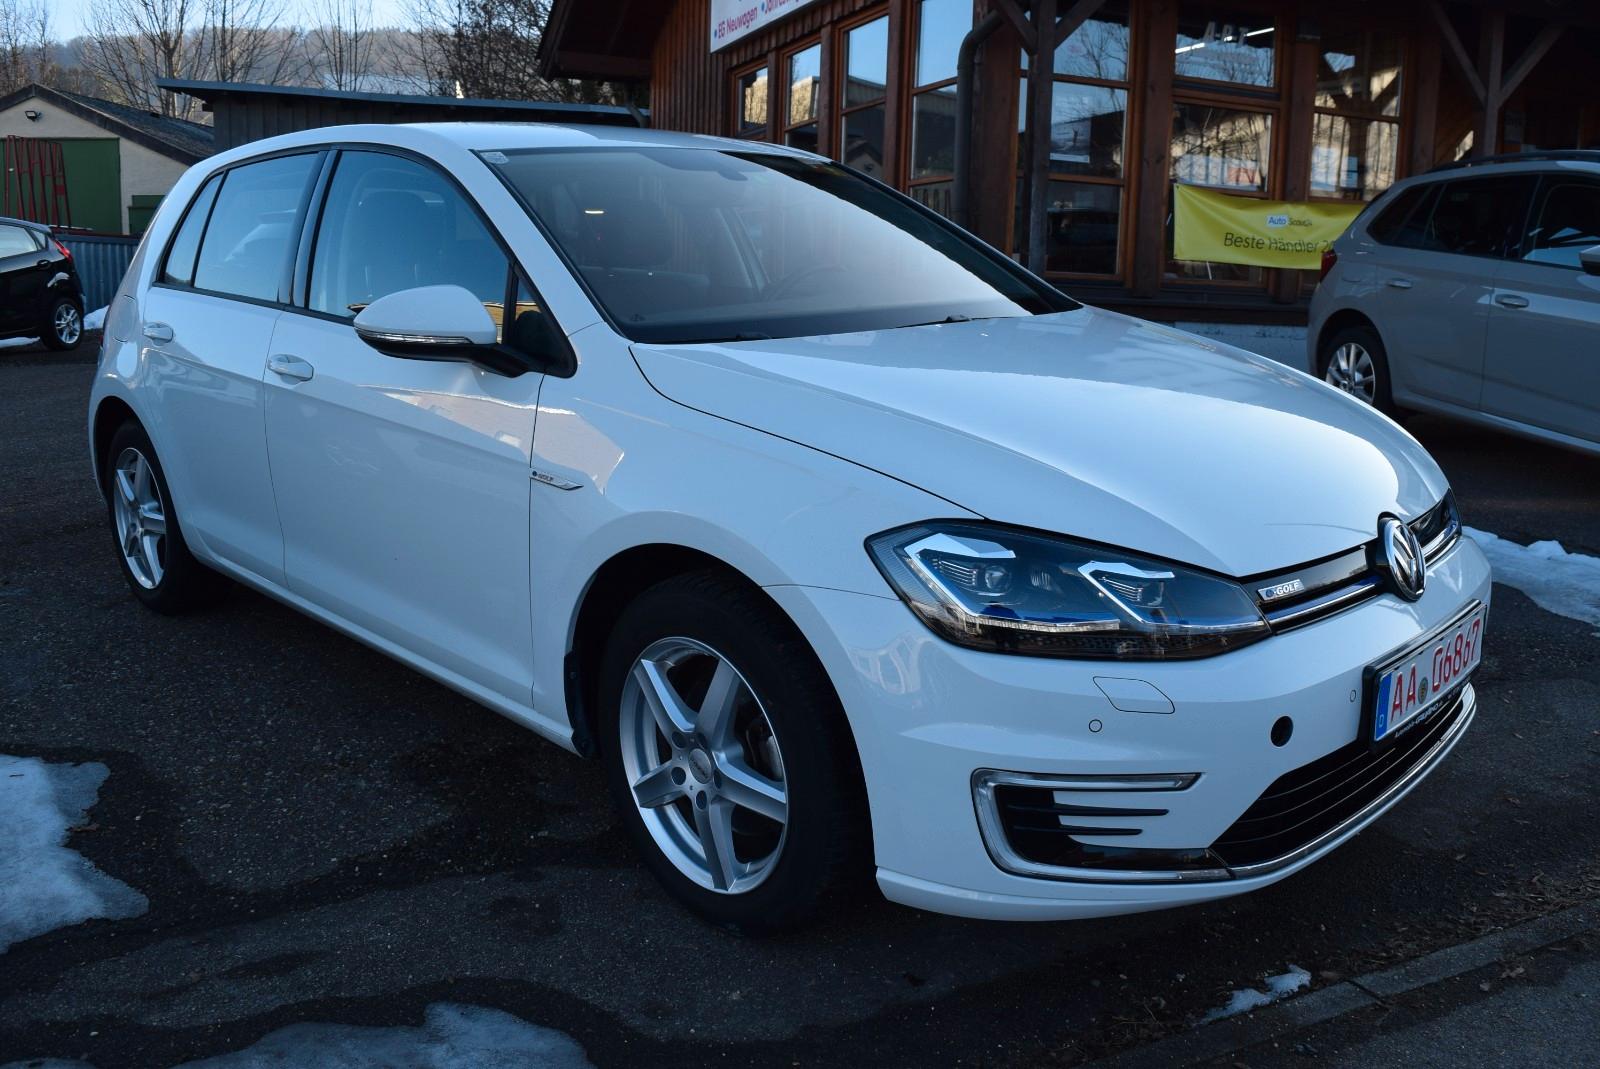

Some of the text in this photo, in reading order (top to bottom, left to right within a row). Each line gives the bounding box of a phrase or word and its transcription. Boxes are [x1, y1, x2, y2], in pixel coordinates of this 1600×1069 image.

[718, 20, 726, 39] EG
[726, 6, 758, 34] Neuwagen
[1223, 231, 1266, 250] Beste
[1268, 237, 1319, 253] Händler
[1390, 661, 1416, 723] AA
[1431, 616, 1481, 693] 06867
